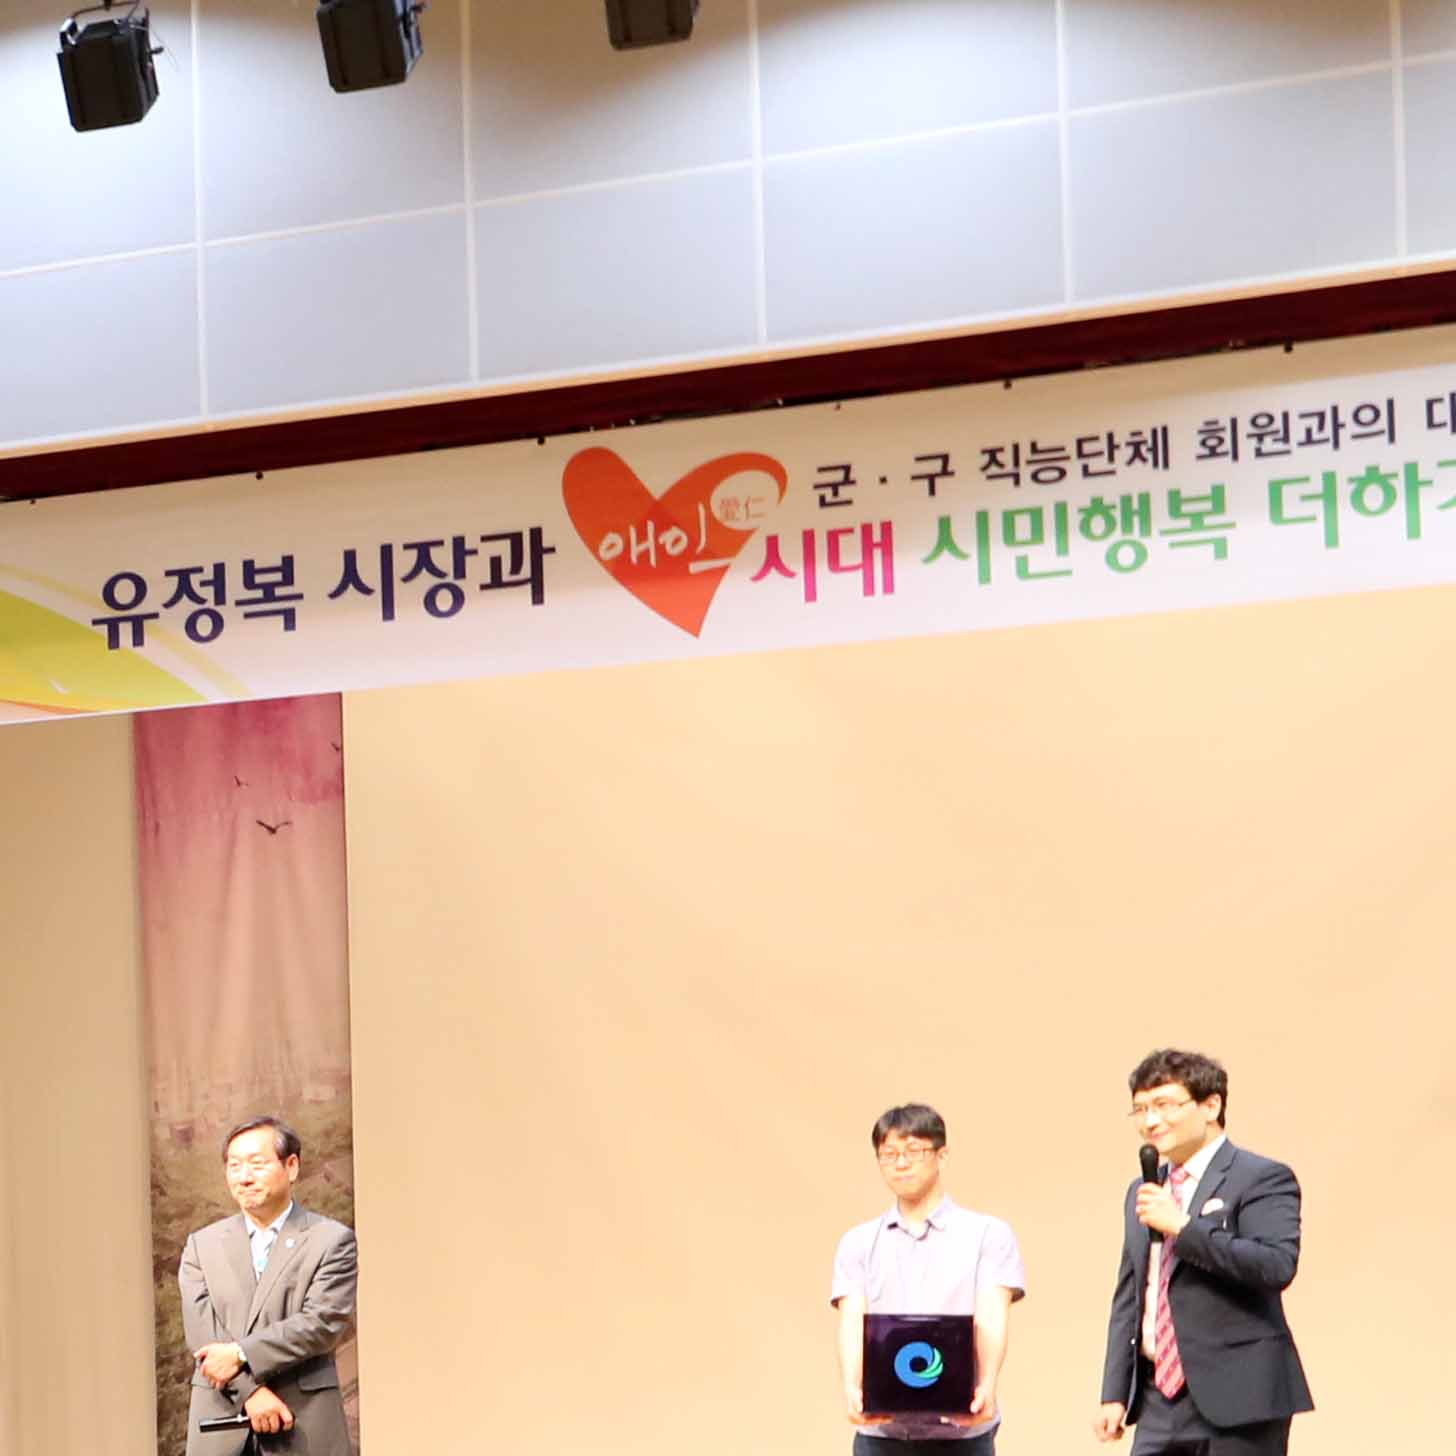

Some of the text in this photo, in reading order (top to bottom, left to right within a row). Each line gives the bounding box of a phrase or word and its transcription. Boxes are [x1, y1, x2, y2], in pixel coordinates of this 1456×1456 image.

[979, 427, 1172, 488] 직능단체
[1196, 398, 1396, 463] 회원과의
[91, 554, 304, 651] 유정복
[327, 524, 556, 623] 시장과
[749, 518, 897, 604] 시대
[920, 482, 1237, 587] 시민행복
